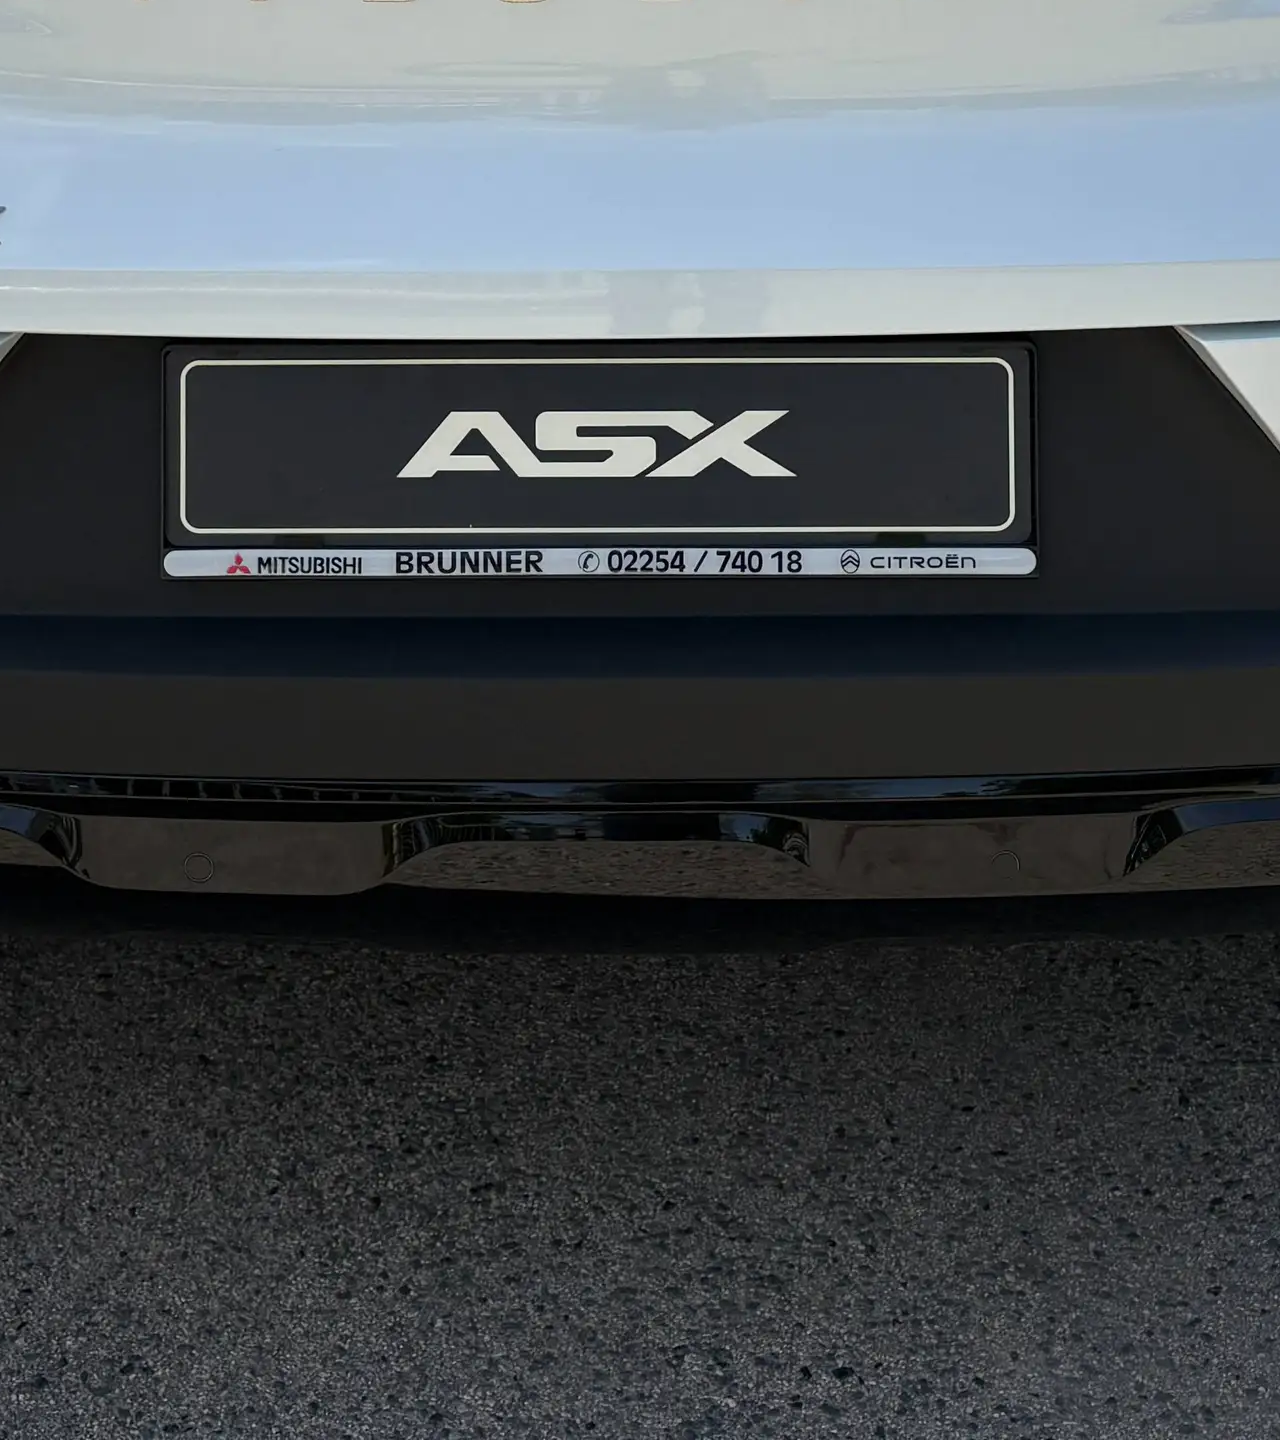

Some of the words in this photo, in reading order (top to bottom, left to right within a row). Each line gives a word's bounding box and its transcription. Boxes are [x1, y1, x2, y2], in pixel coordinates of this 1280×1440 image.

[396, 410, 798, 478] ASX
[257, 556, 363, 575] MITSUBISHI
[395, 551, 544, 574] BRUNNER
[607, 550, 686, 573] 02254
[693, 550, 708, 573] /
[716, 550, 764, 573] 740
[771, 550, 803, 573] 18
